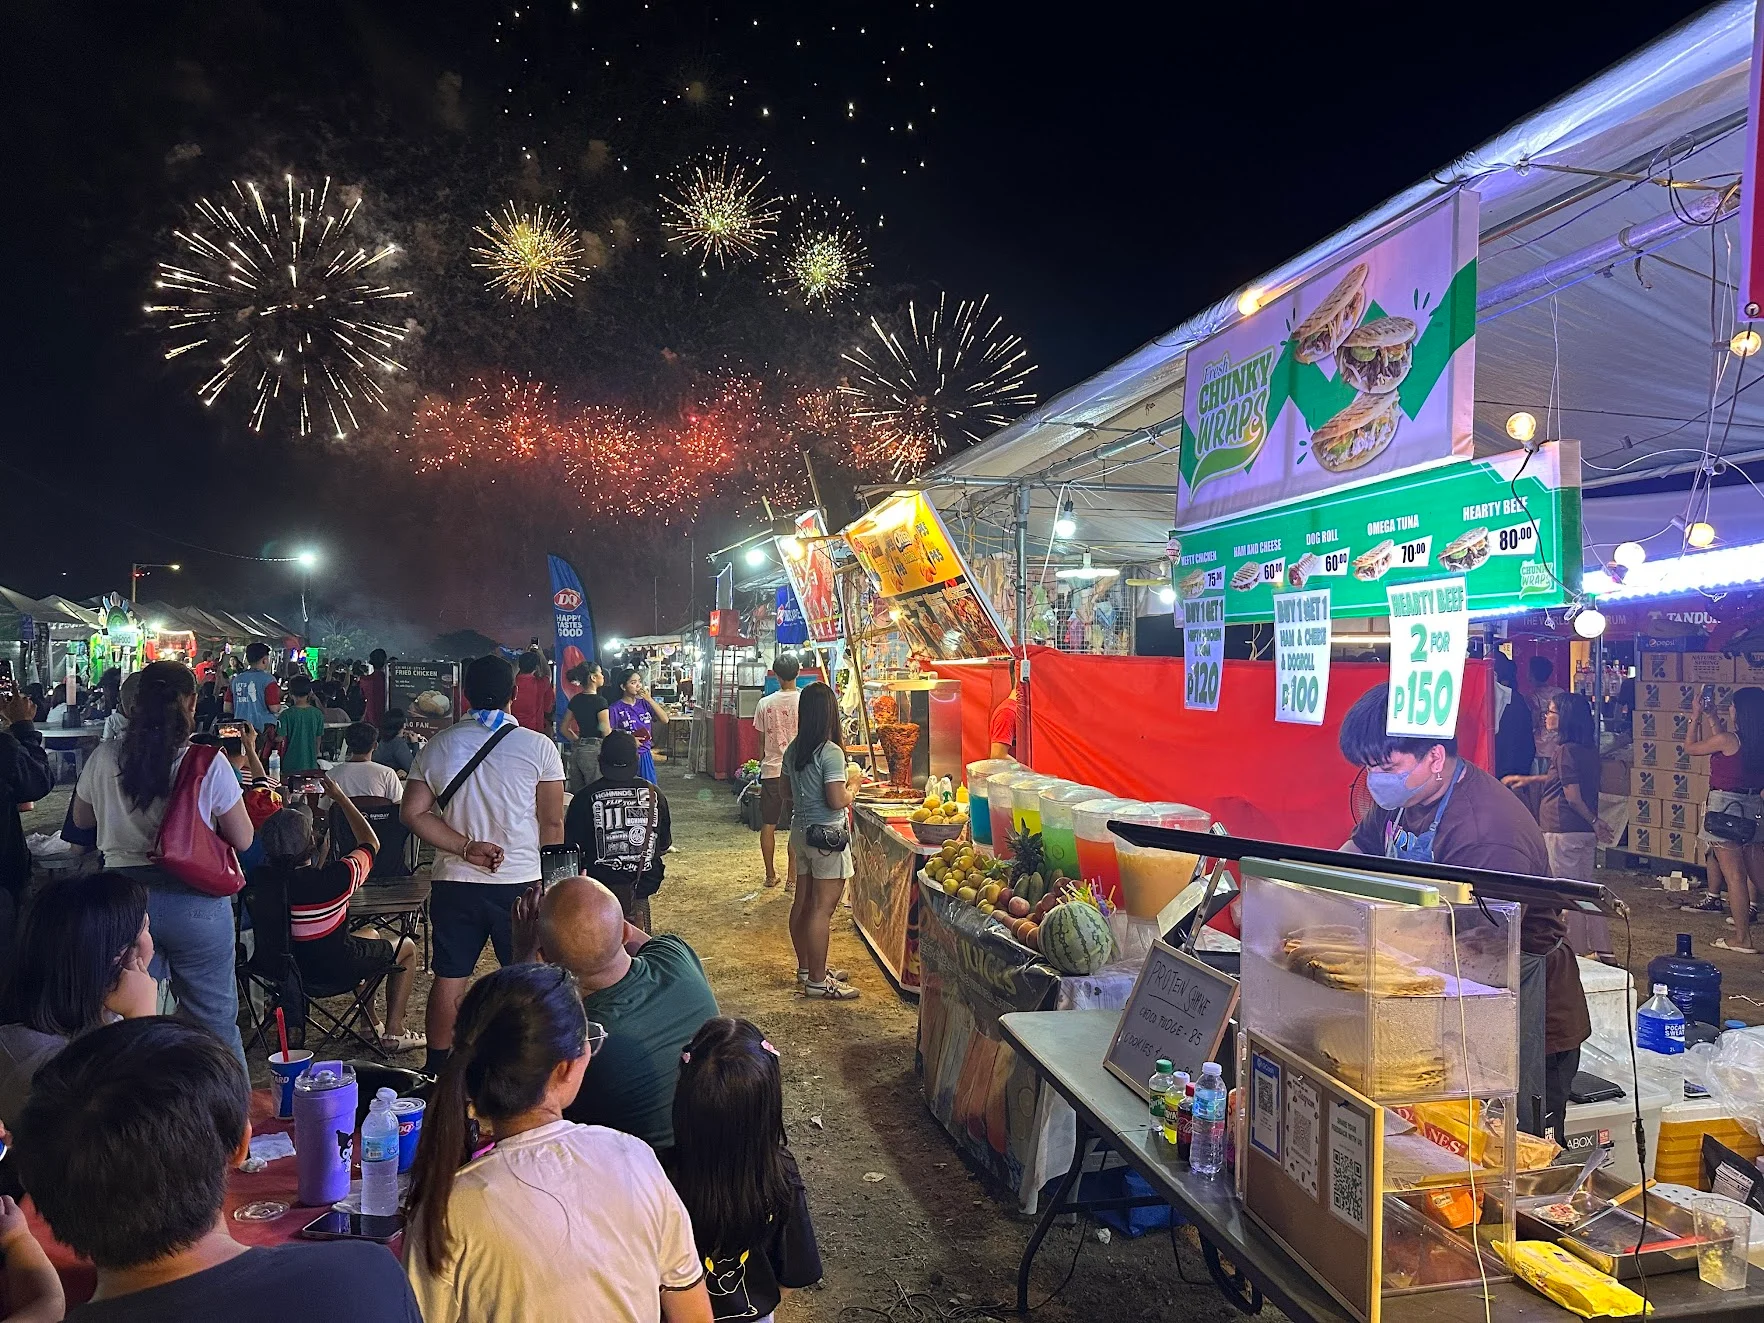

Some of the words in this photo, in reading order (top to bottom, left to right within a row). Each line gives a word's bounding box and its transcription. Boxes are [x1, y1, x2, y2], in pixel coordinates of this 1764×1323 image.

[1203, 355, 1229, 384] Fresh
[1199, 351, 1273, 415] CHUNKY
[1196, 387, 1268, 455] WRAPS
[1463, 500, 1501, 521] HEARTY
[1503, 495, 1528, 516] BEEF
[1367, 517, 1396, 536] OMEGA
[1396, 514, 1420, 530] TUNA
[1305, 533, 1321, 546] DOG
[1321, 529, 1339, 543] ROLL
[1499, 526, 1533, 551] 80.00
[1195, 551, 1217, 564] CHICKEN
[1233, 545, 1246, 558] HAM
[1259, 539, 1282, 554] CHEESE
[1401, 542, 1426, 564] 70.00
[1263, 562, 1283, 580] 60.00
[1325, 553, 1348, 573] 60.00
[1522, 574, 1551, 586] WRAPS
[557, 593, 578, 607] DQ
[1391, 588, 1434, 618] HEARTY
[1436, 585, 1465, 614] BEEF
[556, 614, 581, 622] HAPPY
[1185, 601, 1200, 624] BUY
[1205, 599, 1219, 622] GET
[1276, 600, 1295, 624] BUY
[1296, 598, 1303, 623] 1
[1303, 596, 1322, 621] GET
[1666, 611, 1721, 625] TANDU
[556, 621, 583, 629] TASTES
[1523, 616, 1539, 626] THE
[557, 628, 583, 637] GOOD
[1279, 630, 1295, 647] HAM
[1304, 627, 1327, 646] CHEESE
[1410, 622, 1428, 663] 2
[1430, 631, 1450, 653] FOR
[1656, 639, 1675, 647] pepsi
[1287, 653, 1315, 671] DOGROLL
[415, 721, 430, 729] FAN
[1147, 960, 1190, 997] PROTEIN
[1184, 985, 1212, 1016] SHAKE
[1123, 1032, 1154, 1057] COOKIES
[1188, 1028, 1203, 1046] 85
[1566, 1135, 1594, 1150] ABOX
